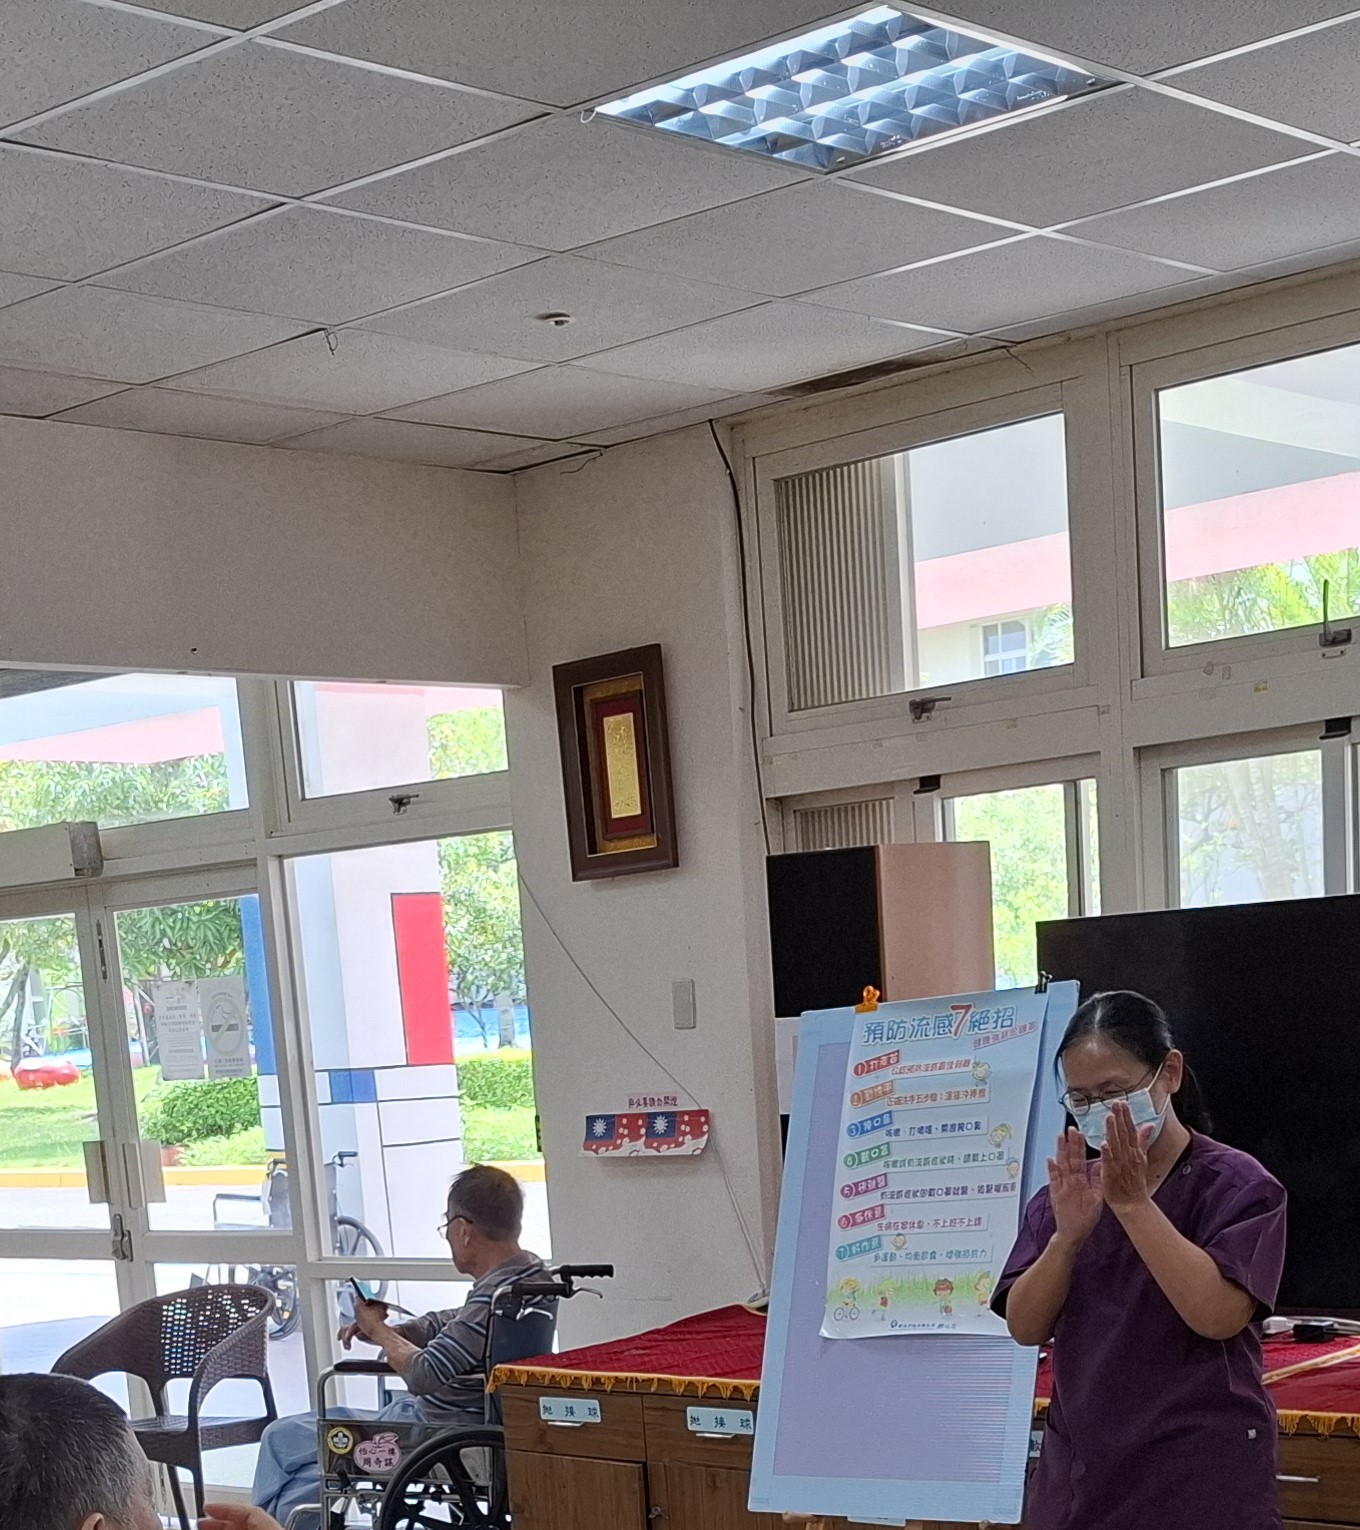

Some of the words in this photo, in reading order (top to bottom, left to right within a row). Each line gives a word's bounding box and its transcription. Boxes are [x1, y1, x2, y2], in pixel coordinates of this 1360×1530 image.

[863, 1003, 1016, 1044] 預防流感7絕招
